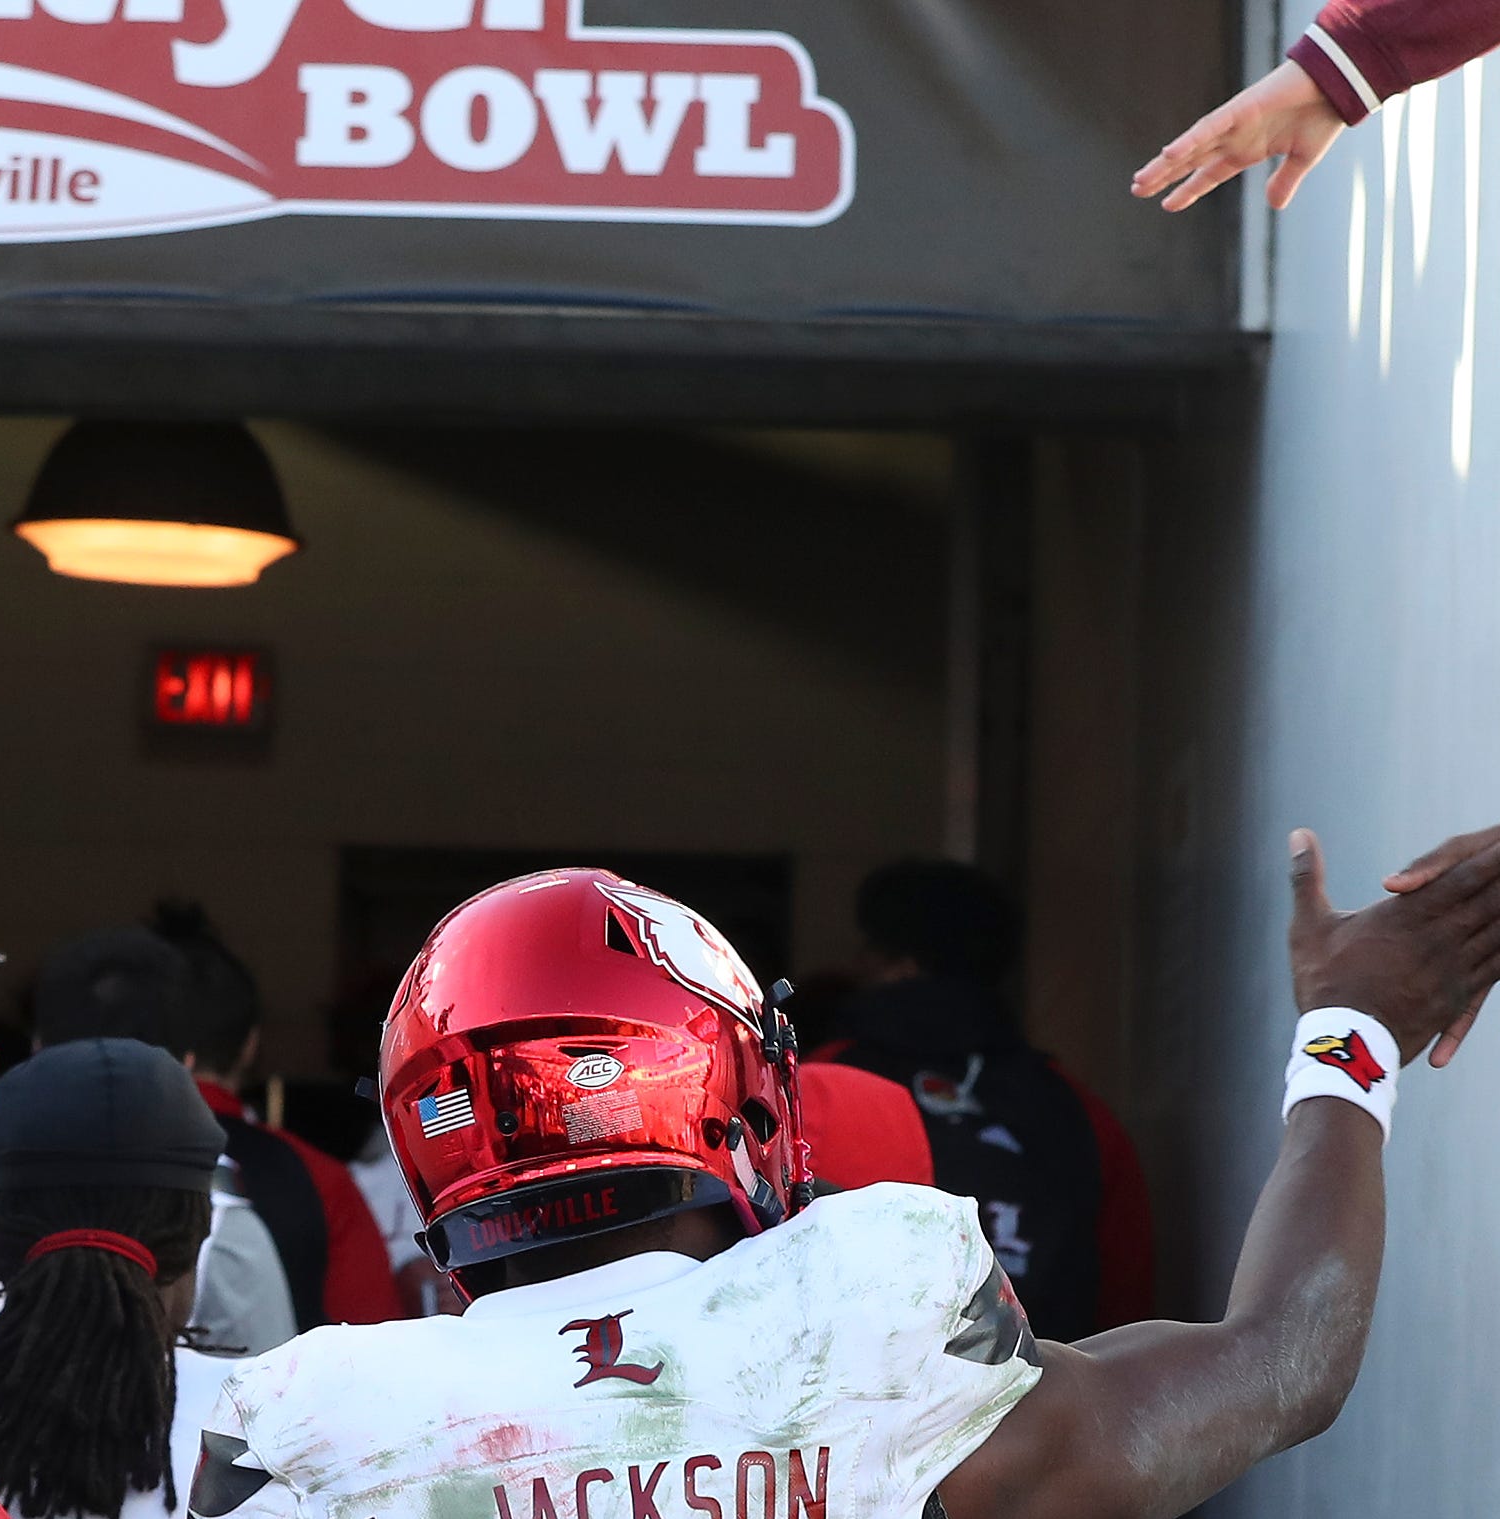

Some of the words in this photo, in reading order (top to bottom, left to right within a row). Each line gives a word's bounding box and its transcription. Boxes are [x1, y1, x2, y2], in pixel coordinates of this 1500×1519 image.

[296, 64, 796, 178] BOWL
[577, 1061, 613, 1079] ACC
[557, 1308, 665, 1389] L
